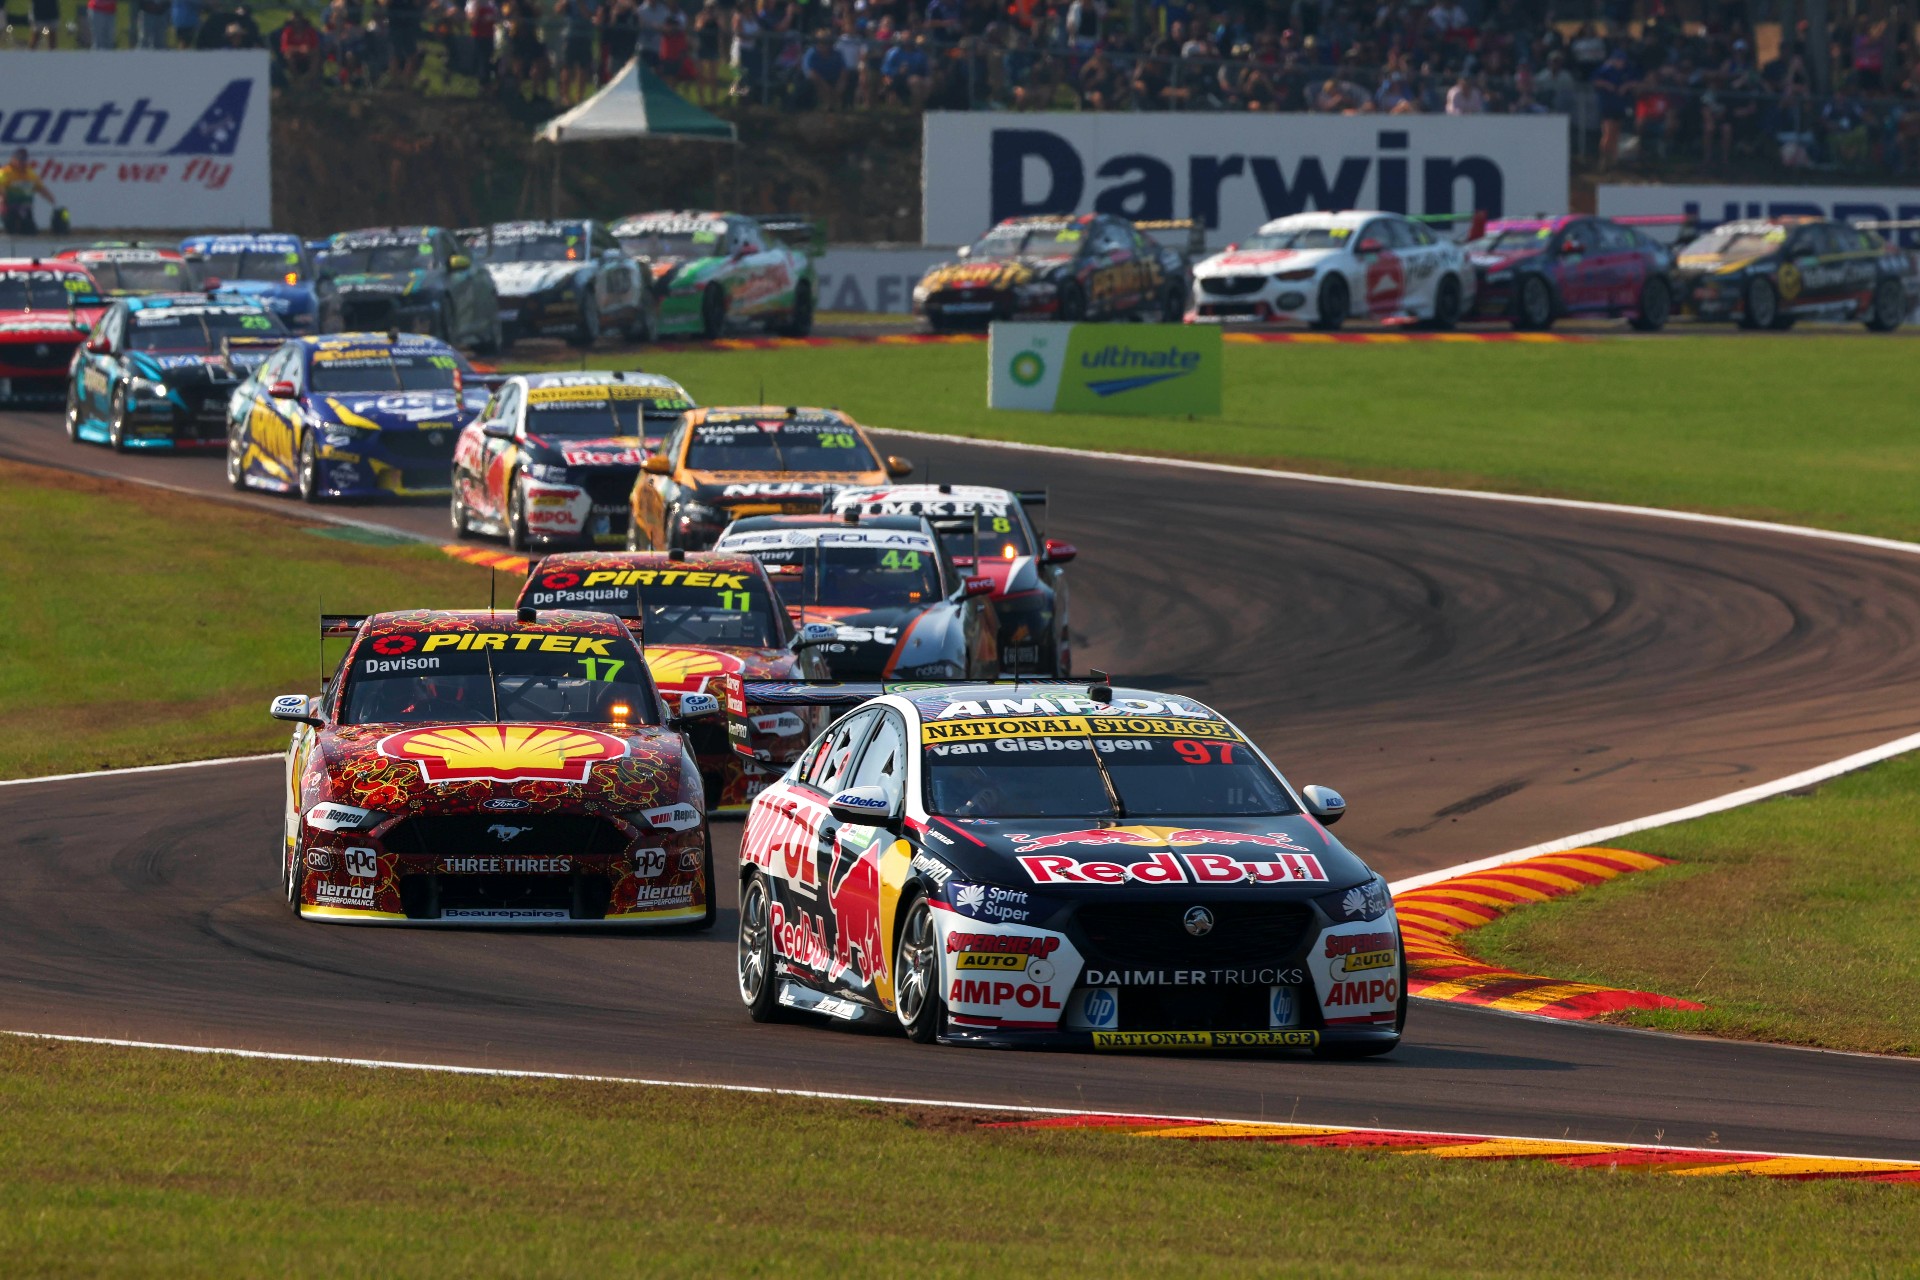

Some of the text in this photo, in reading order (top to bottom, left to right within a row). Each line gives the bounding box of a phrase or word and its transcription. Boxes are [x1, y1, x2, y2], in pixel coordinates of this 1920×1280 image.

[0, 98, 170, 145] orth
[118, 163, 168, 182] we
[181, 156, 233, 190] fly
[991, 129, 1504, 229] Darwin
[240, 315, 271, 329] 25
[1082, 345, 1200, 369] ultimate
[817, 433, 856, 449] 20
[833, 500, 1008, 517] TIMKEN
[992, 517, 1011, 533] 8
[819, 533, 929, 547] SOLAR
[881, 550, 921, 571] 44
[583, 570, 750, 589] PIRTEK
[533, 587, 629, 605] De Pasquale
[717, 591, 750, 613] 11
[421, 632, 617, 656] PIRTEK
[365, 656, 440, 674] Davison
[578, 657, 624, 682] 17
[274, 706, 301, 714] Doric
[691, 703, 717, 713] Doric
[925, 718, 1231, 739] NATIONAL STORAGE
[933, 737, 1153, 757] van Gisbergen
[1173, 739, 1234, 765] 97
[492, 800, 520, 809] Ford
[835, 795, 887, 808] ACDelco
[326, 809, 363, 825] Repco
[674, 809, 697, 822] Repco
[308, 852, 329, 867] CRC
[443, 858, 571, 873] THREE THREES
[681, 852, 700, 866] CRC
[1015, 852, 1329, 884] Red Bull
[316, 880, 375, 900] Herrod
[637, 881, 693, 900] Herrod
[988, 887, 1029, 905] Spirit
[328, 896, 375, 907] PERFORMANCE
[653, 895, 693, 906] PERFORMANCE
[445, 909, 565, 919] Beaurepaires
[984, 903, 1030, 921] Super
[946, 931, 1060, 960] SUPERCHEAP
[963, 955, 1018, 967] AUTO
[1351, 952, 1391, 968] AUTO
[1086, 968, 1303, 986] DAIMLER TRUCKS
[949, 979, 1061, 1010] AMPOL
[1324, 978, 1398, 1007] AMPO
[1090, 990, 1113, 1025] hp
[1276, 988, 1291, 1023] hp
[1097, 1032, 1312, 1047] NATIONAL STORAGE
